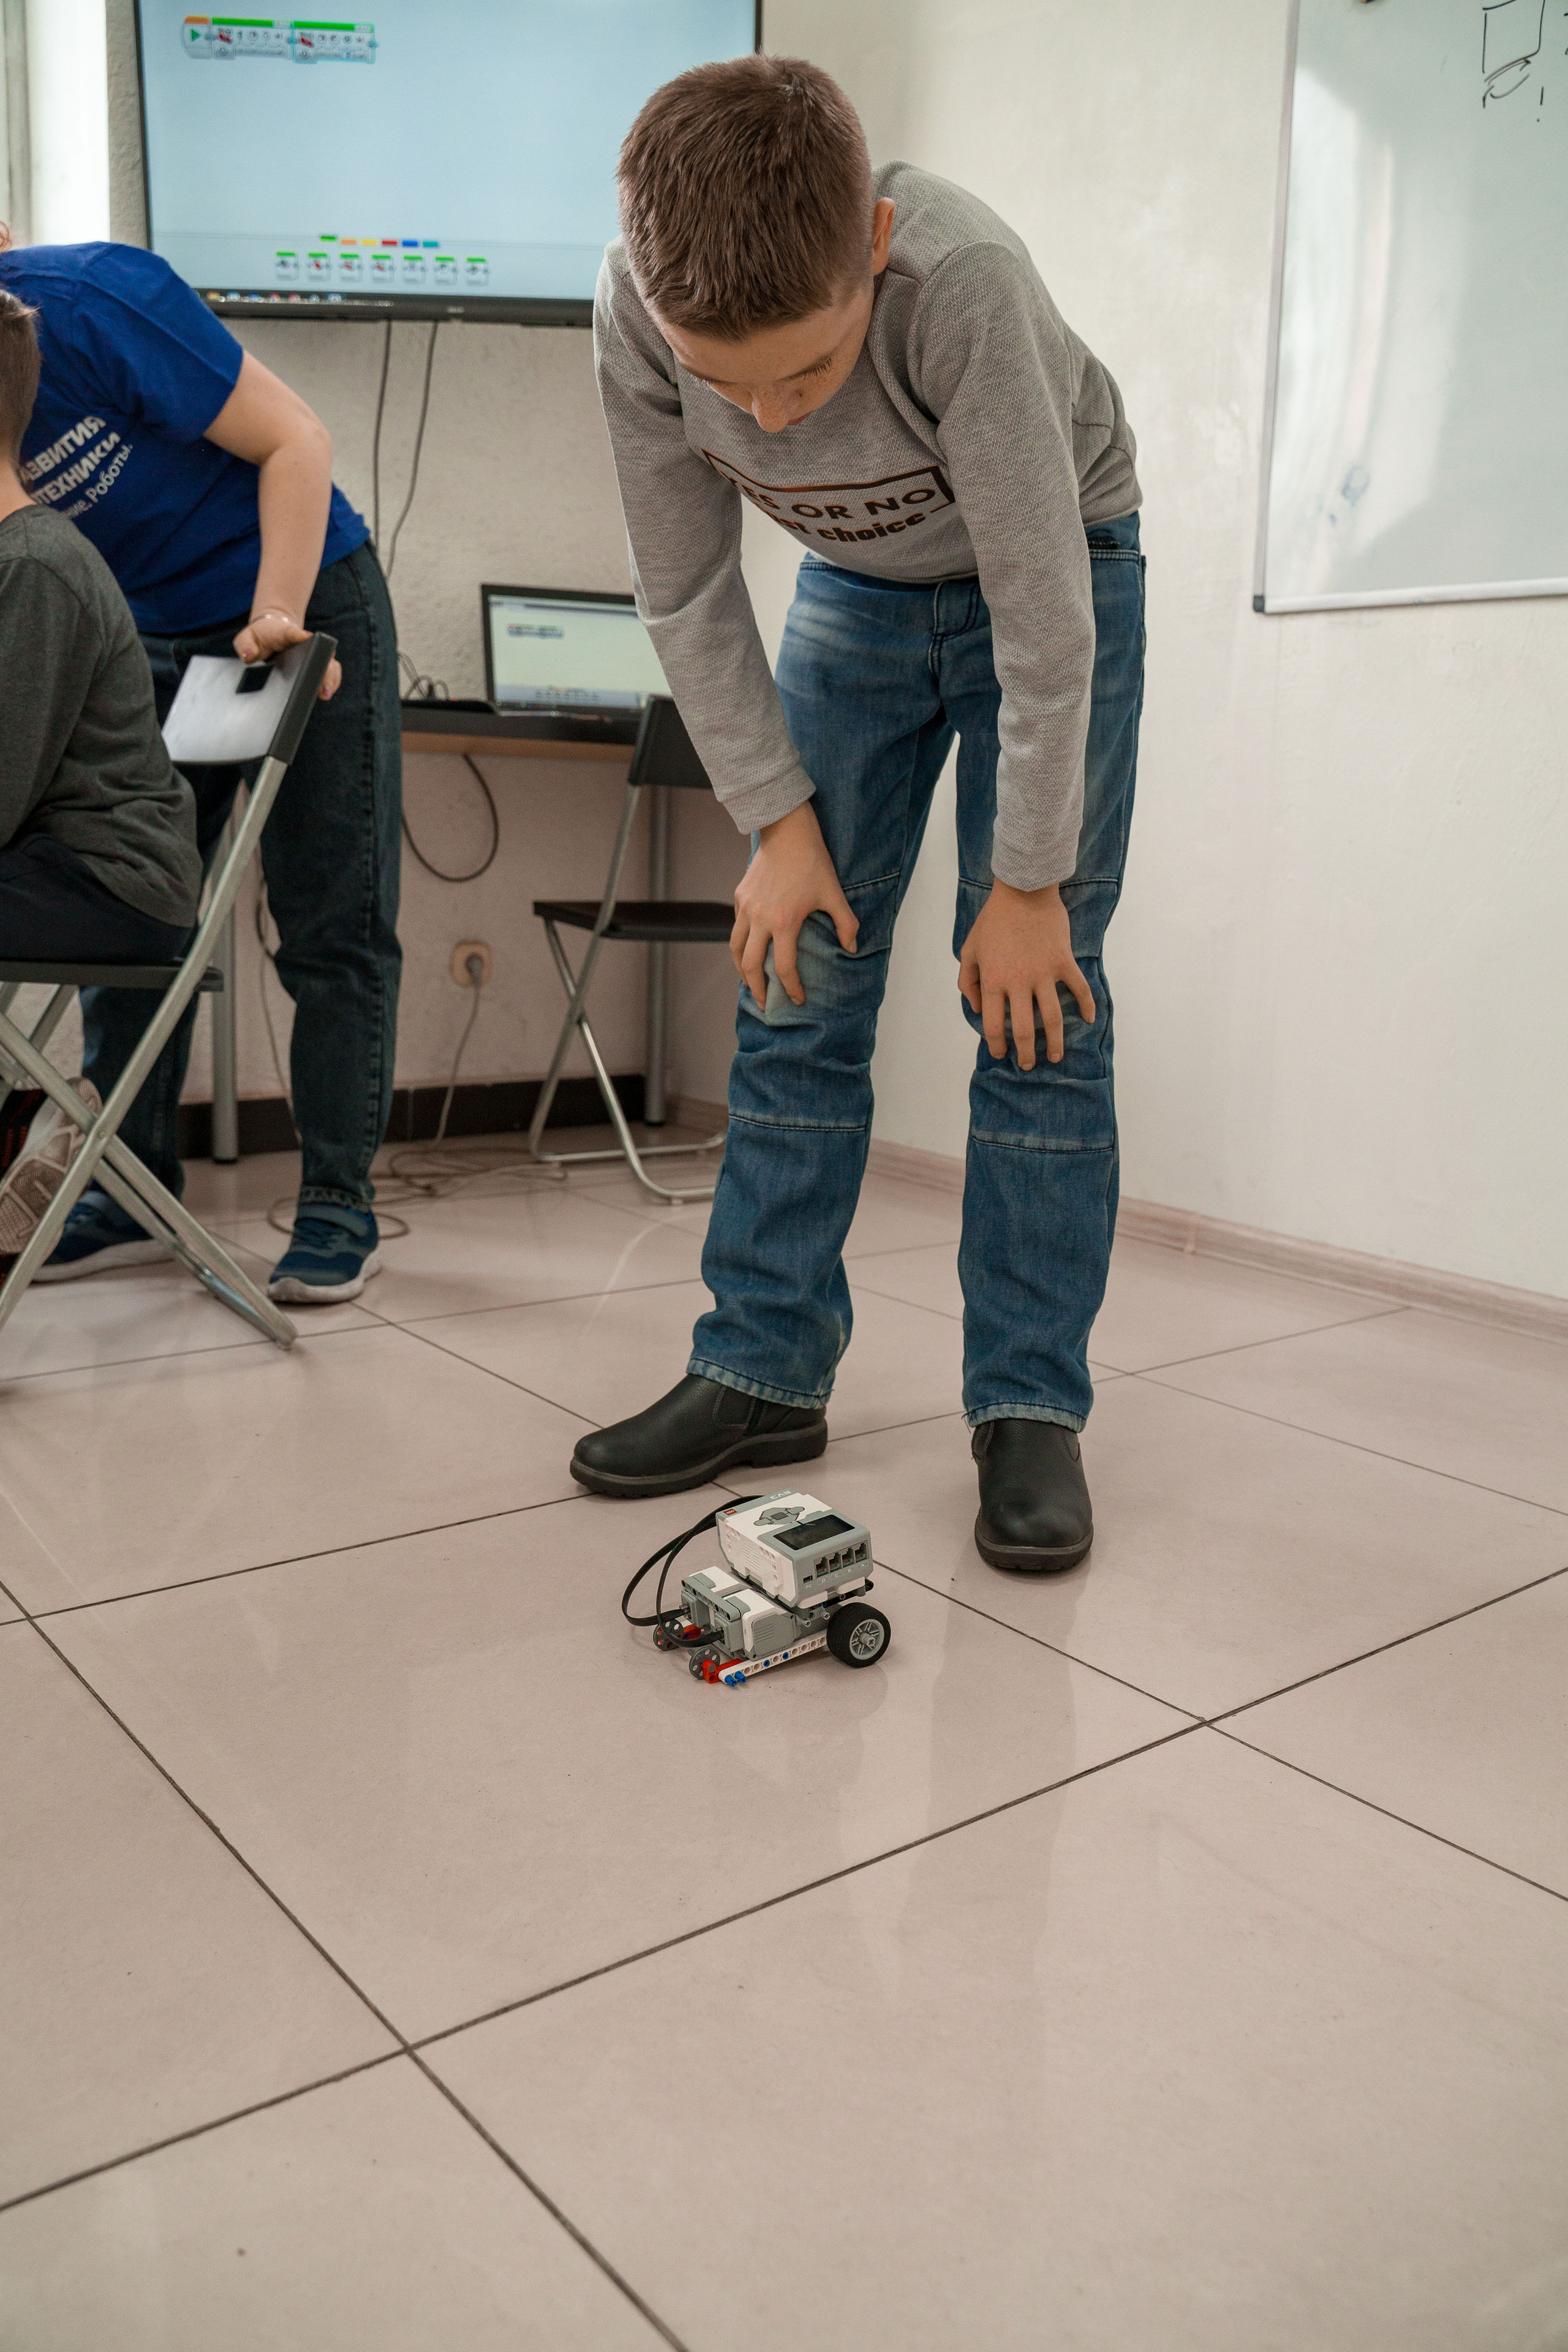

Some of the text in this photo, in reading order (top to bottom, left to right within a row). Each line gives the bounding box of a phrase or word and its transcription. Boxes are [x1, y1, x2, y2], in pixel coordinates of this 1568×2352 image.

[85, 445, 133, 503] Роботы.
[791, 503, 854, 519] OR
[864, 488, 935, 515] NO
[816, 512, 925, 541] choice
